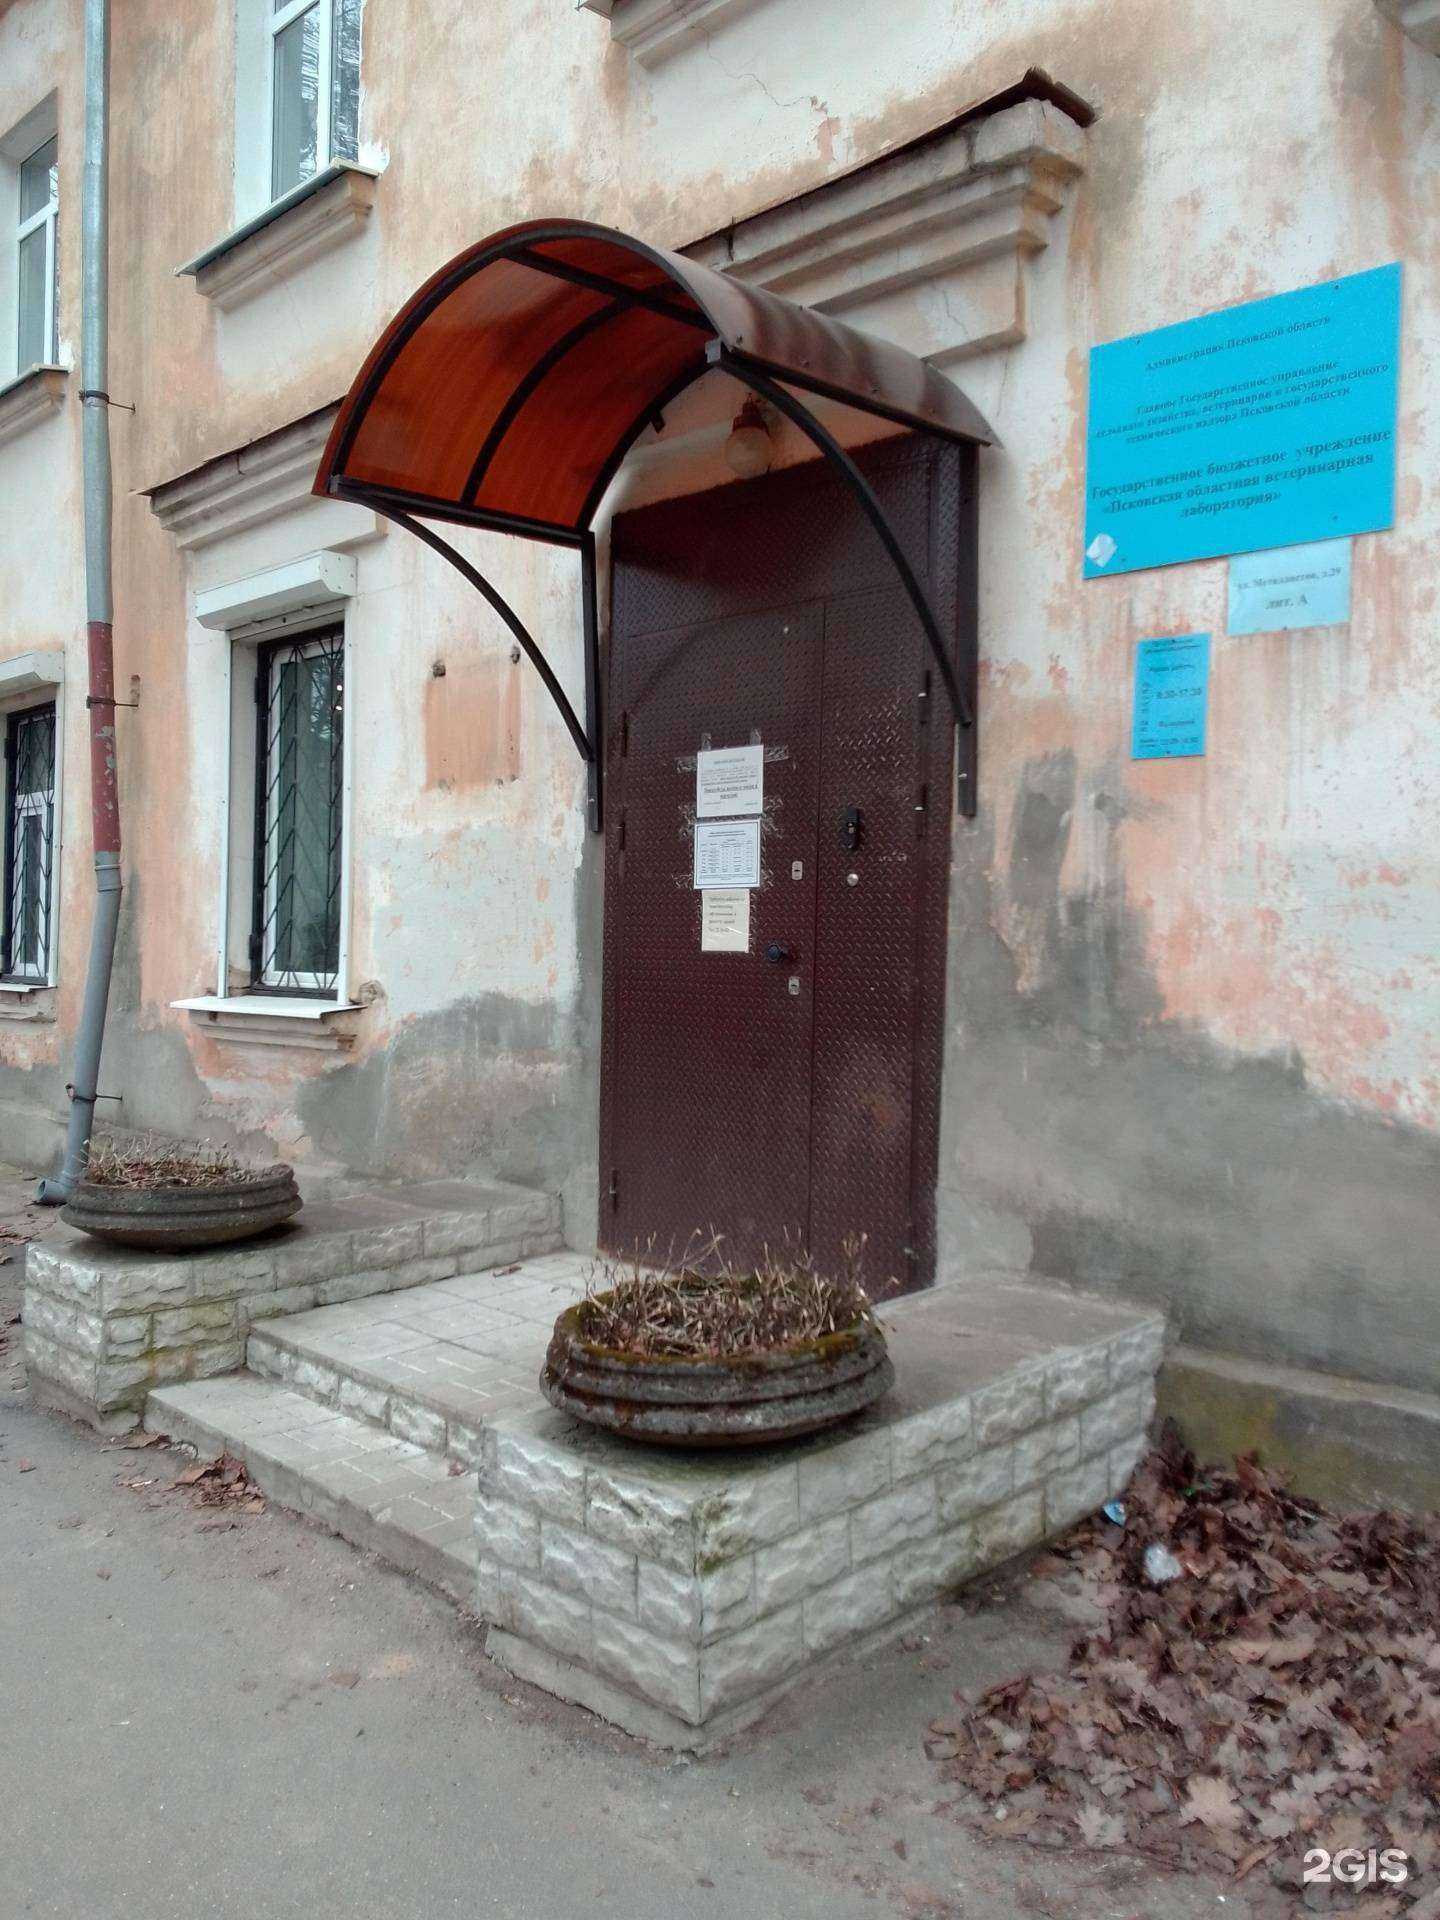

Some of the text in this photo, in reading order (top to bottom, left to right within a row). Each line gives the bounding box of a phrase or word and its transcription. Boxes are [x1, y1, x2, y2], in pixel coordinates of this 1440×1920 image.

[1092, 430, 1391, 499] Государственное бюджетное учреждение
[1186, 476, 1260, 498] областная
[1264, 454, 1374, 483] ветеринарная
